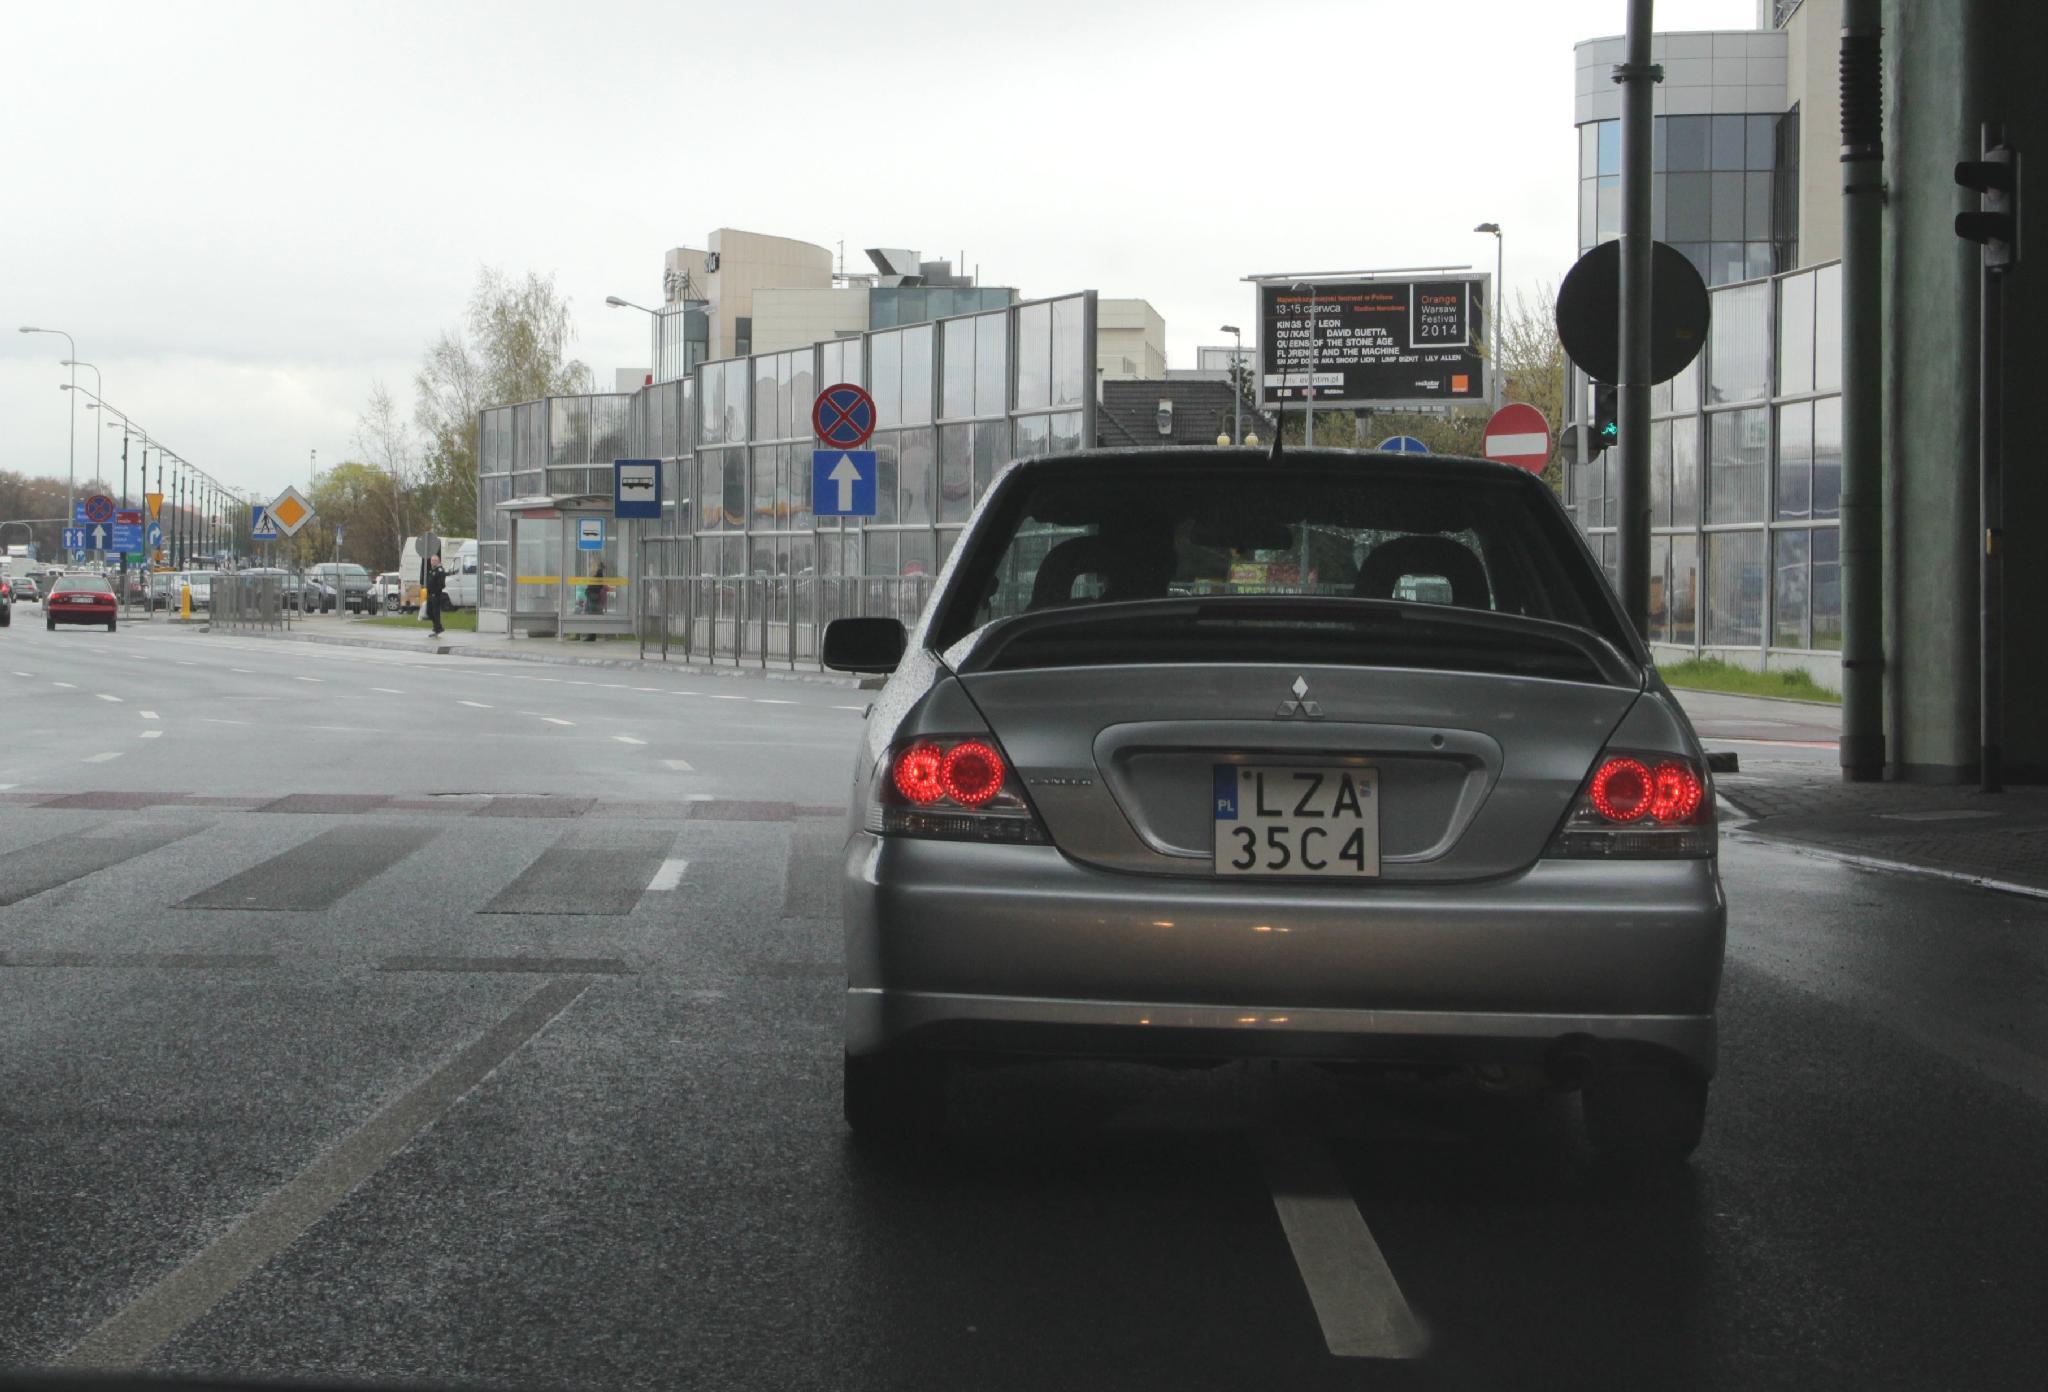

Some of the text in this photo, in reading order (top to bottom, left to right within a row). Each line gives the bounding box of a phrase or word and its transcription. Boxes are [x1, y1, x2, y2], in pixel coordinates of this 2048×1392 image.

[1422, 296, 1457, 305] Orange
[1276, 304, 1301, 314] 13-15
[1422, 314, 1457, 323] Festival
[1276, 320, 1302, 329] KINGS
[1318, 320, 1341, 328] LEON
[1421, 324, 1457, 336] 2014
[1327, 328, 1352, 337] DAVID
[1354, 328, 1387, 336] GUETTA
[1276, 337, 1394, 348] QUEENS OF THE STONE AGE
[1276, 347, 1400, 358] FLORENE AND THE MACHINE
[1256, 772, 1363, 819] LZA
[1217, 799, 1235, 812] PL
[1231, 826, 1365, 872] 35C4
